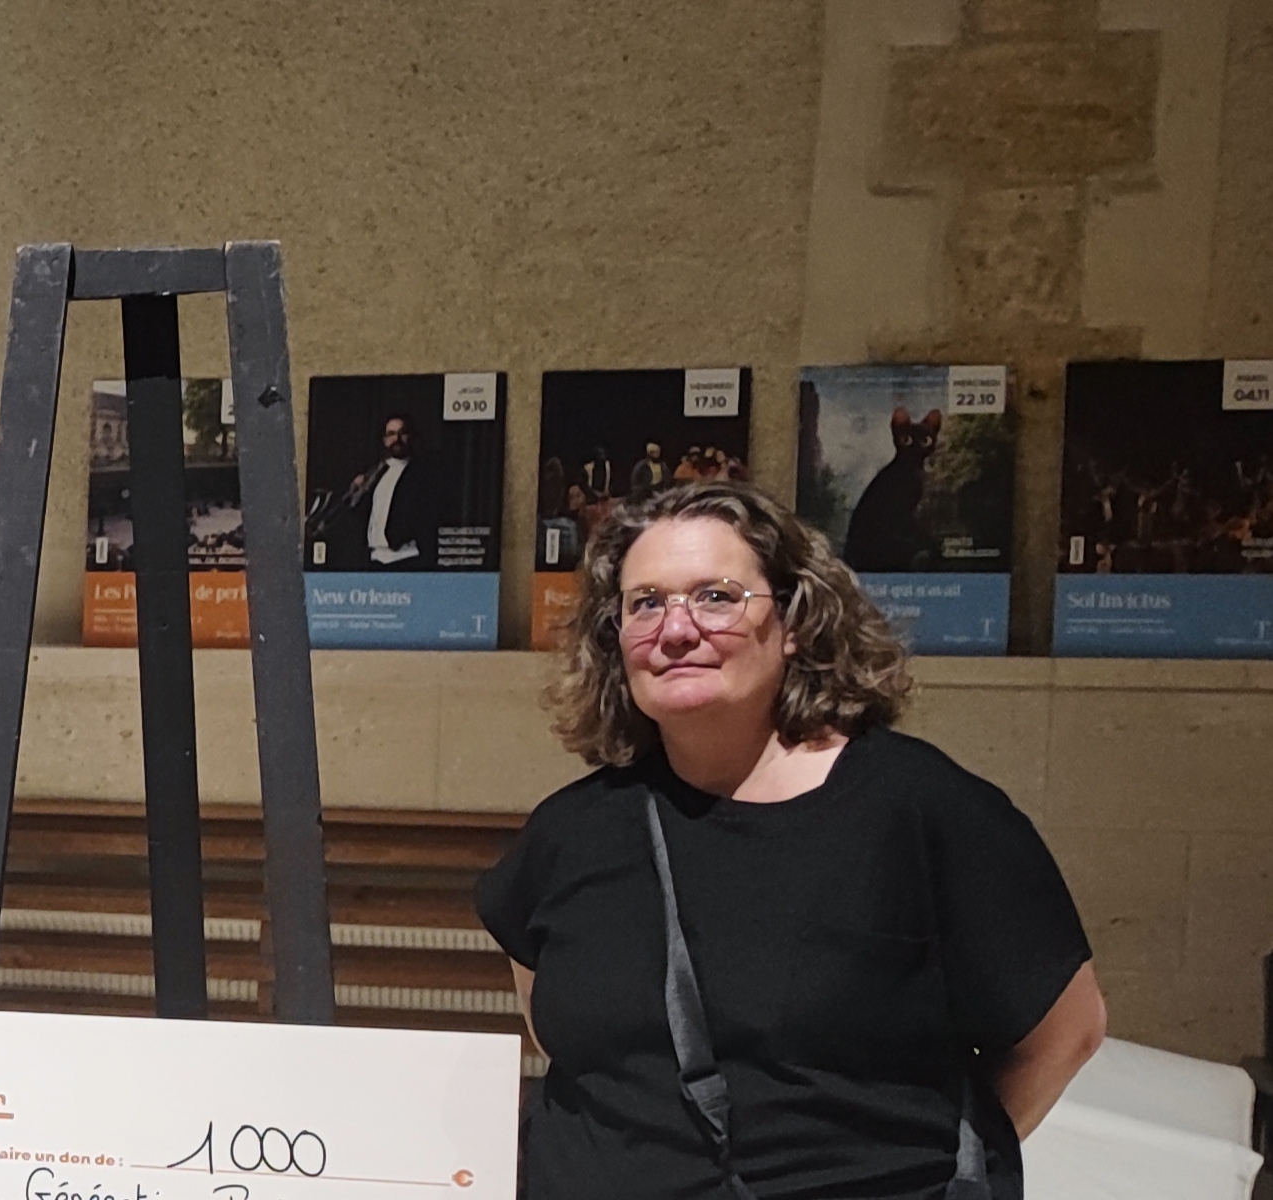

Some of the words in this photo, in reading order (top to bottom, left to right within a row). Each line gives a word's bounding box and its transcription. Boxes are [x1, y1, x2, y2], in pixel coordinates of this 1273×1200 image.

[452, 400, 488, 412] 09.10
[695, 396, 727, 408] 17.10
[956, 393, 996, 406] 22.10
[312, 588, 345, 605] New
[350, 588, 413, 606] Orleans
[35, 1152, 55, 1163] un
[59, 1152, 91, 1165] don
